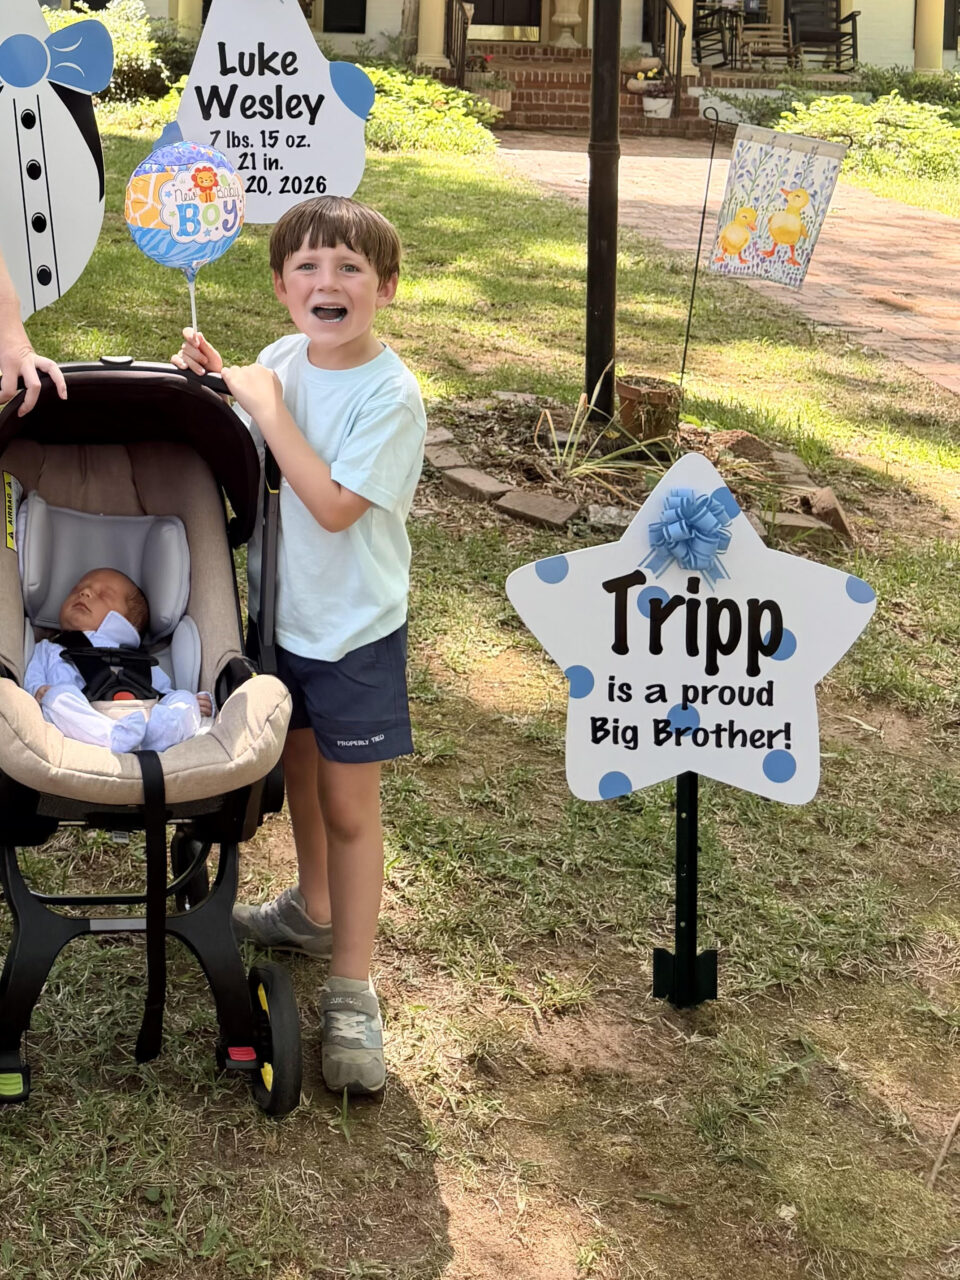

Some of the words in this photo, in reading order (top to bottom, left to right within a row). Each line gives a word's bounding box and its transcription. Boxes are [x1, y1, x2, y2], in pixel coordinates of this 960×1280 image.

[217, 41, 299, 77] Luke
[194, 83, 326, 126] Wesley
[209, 129, 222, 148] 7
[226, 129, 254, 149] lbs.
[260, 129, 280, 149] 15
[285, 133, 311, 149] oz.
[237, 151, 257, 171] 21
[262, 152, 284, 171] in.
[174, 187, 197, 202] New
[216, 184, 241, 201] Baby
[244, 174, 272, 196] 20,
[278, 174, 328, 195] 2026
[6, 493, 14, 526] AIRBAG
[601, 569, 785, 678] Tripp
[607, 675, 633, 703] is
[644, 683, 668, 704] a
[681, 680, 775, 711] proud
[590, 716, 639, 751] Big
[652, 718, 792, 751] Brother!
